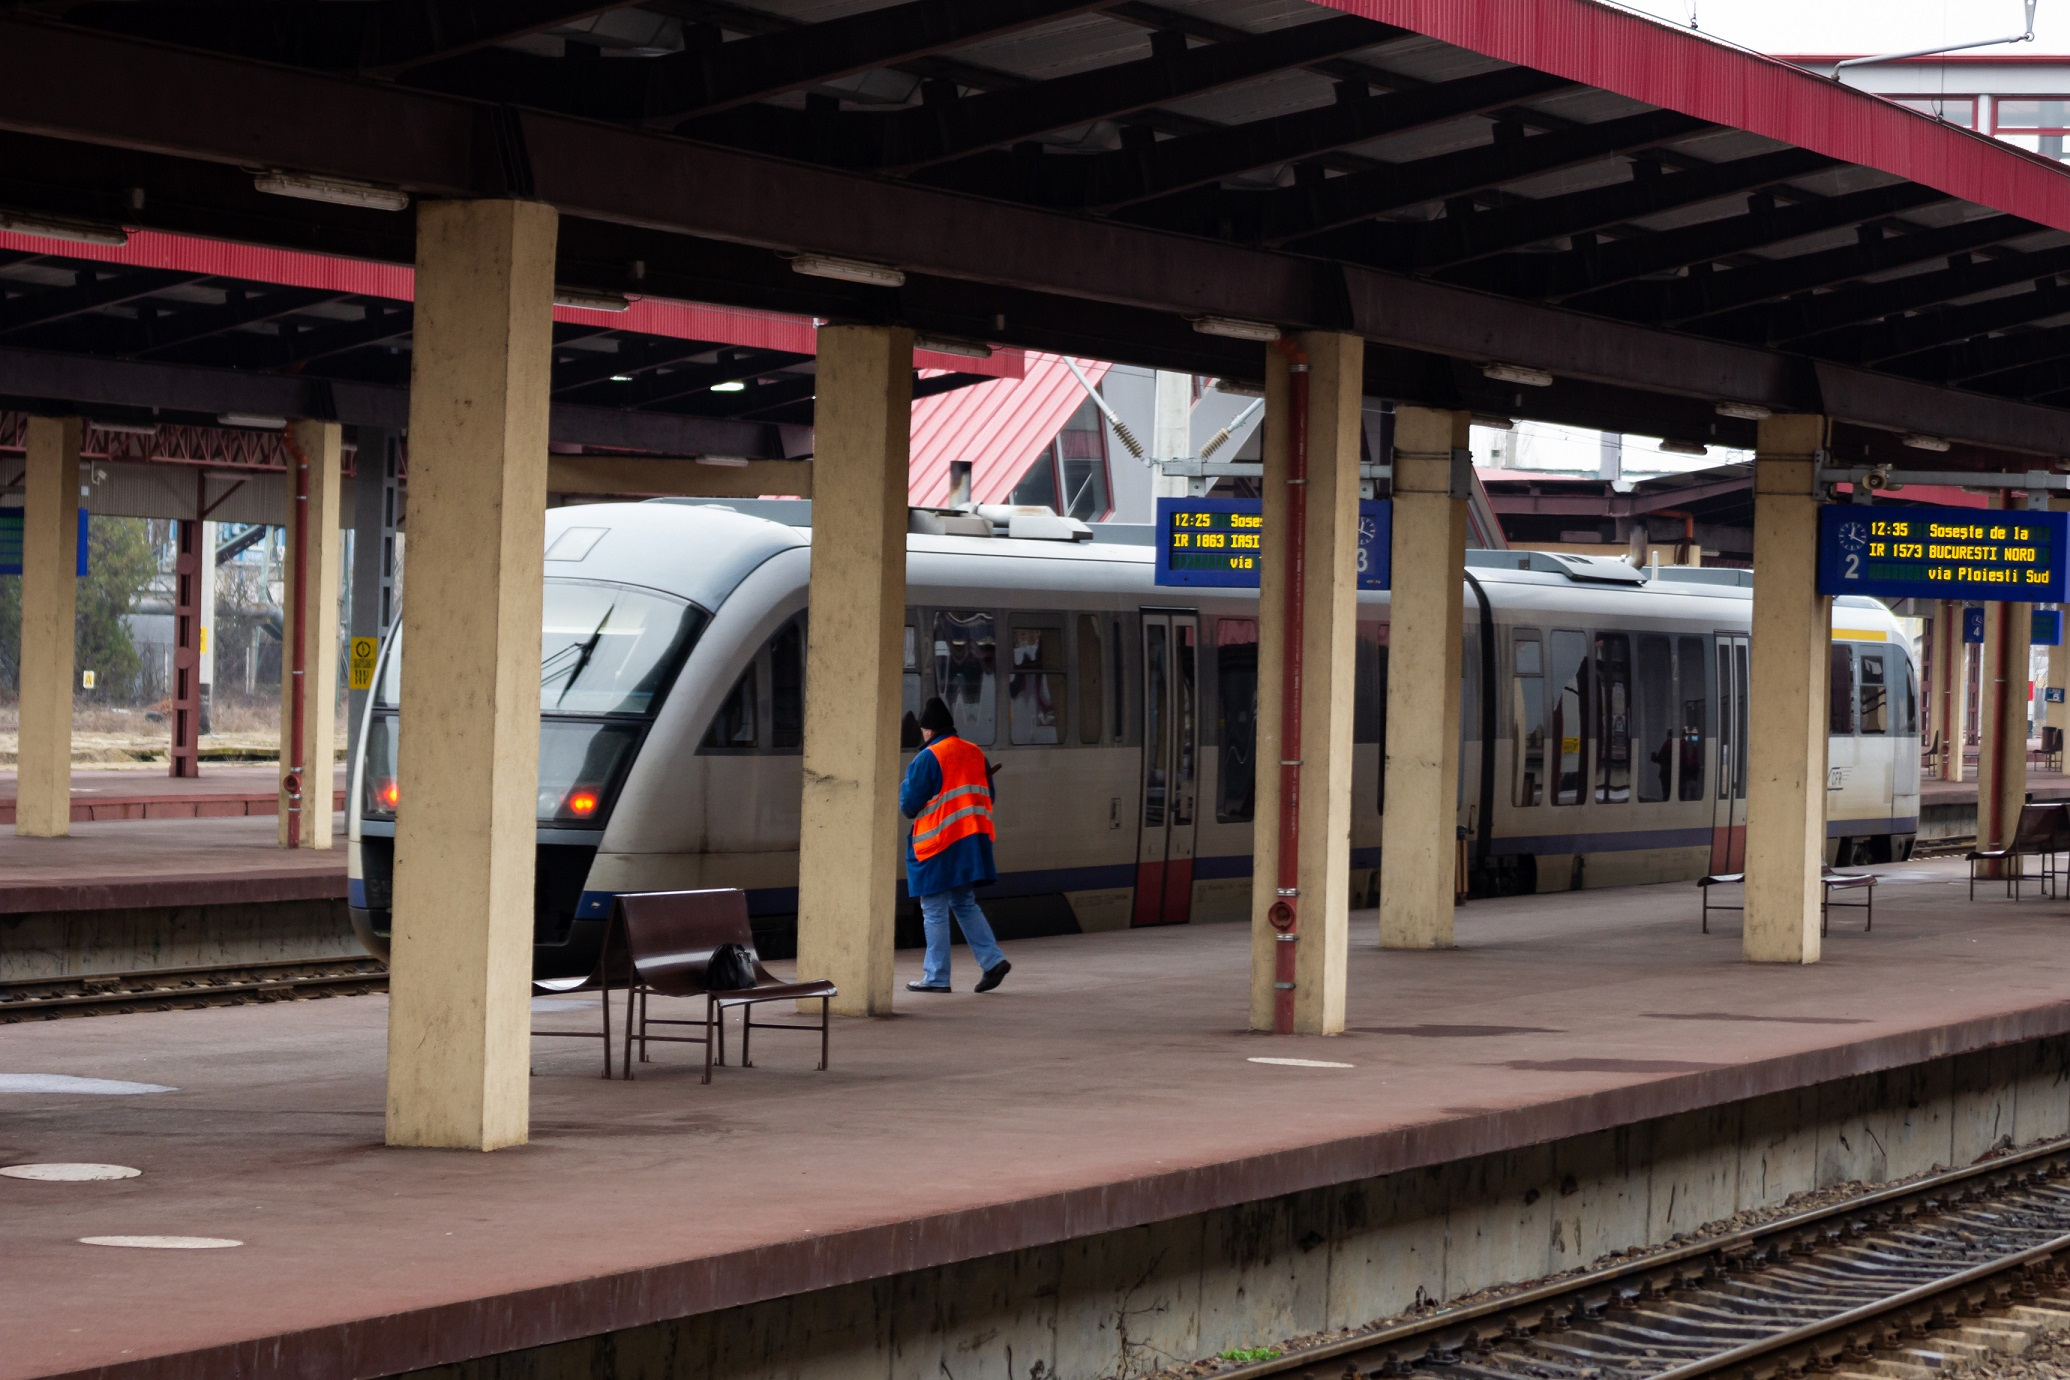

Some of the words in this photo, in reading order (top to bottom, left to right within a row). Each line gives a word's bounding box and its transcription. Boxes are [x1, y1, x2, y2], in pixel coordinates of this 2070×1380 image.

[1175, 513, 1210, 527] 12:25
[1871, 522, 1908, 537] 12:35
[1990, 525, 2006, 539] de
[2014, 527, 2029, 540] la
[1174, 533, 1189, 547] IR
[1196, 534, 1225, 548] 1863
[1230, 534, 1260, 549] IASI
[1869, 543, 1885, 557] IR
[1893, 543, 1923, 558] 1573
[1928, 545, 1997, 561] BUCURESTI
[2004, 548, 2035, 562] NORD
[1230, 556, 1253, 569] via
[1844, 554, 1859, 579] 2
[1928, 567, 1951, 580] via
[1958, 567, 2018, 583] Ploiesti
[2025, 569, 2050, 584] Sud
[1973, 626, 1980, 636] 4
